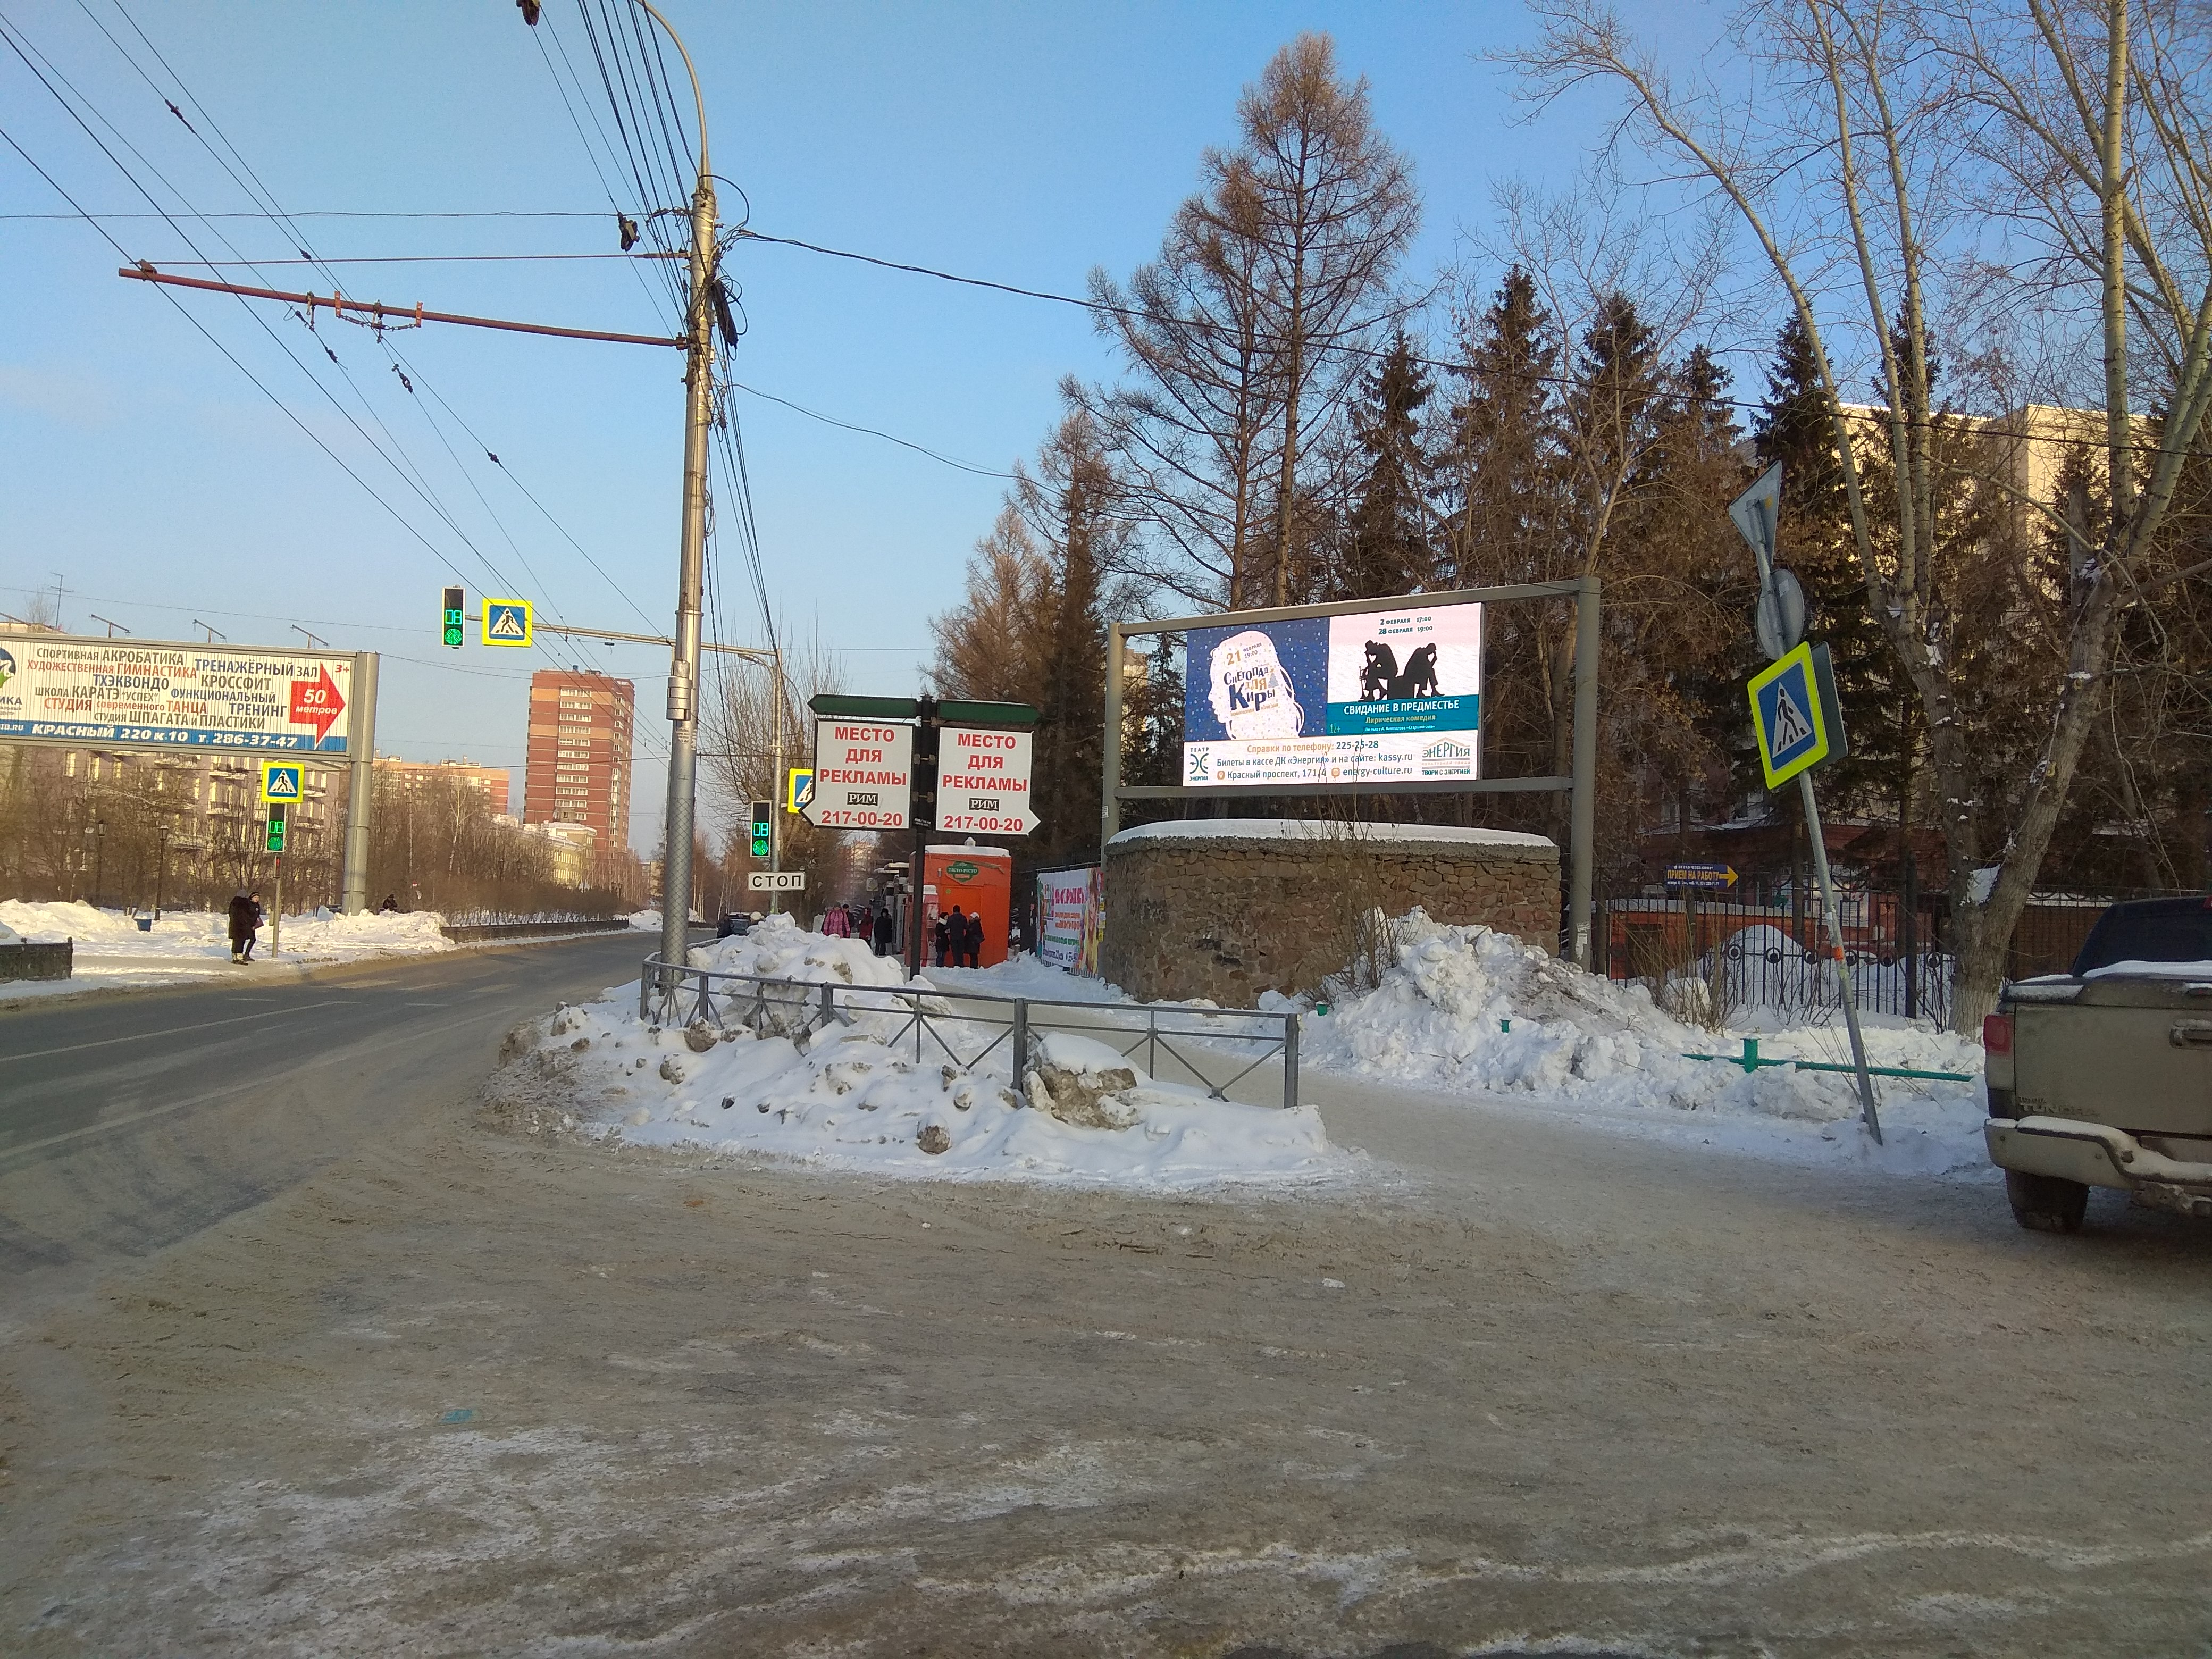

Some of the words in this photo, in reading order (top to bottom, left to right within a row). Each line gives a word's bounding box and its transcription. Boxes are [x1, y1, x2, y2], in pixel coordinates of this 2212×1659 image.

[37, 647, 99, 660] СПОРТИВНАЯ
[102, 649, 183, 665] АКРОБАТИКА
[1226, 650, 1241, 665] 21
[1243, 642, 1262, 652] ФЕВРАЛЯ
[1244, 650, 1258, 659] 19:00
[27, 659, 114, 674] ХУДОЖЕСТВЕННАЯ
[117, 663, 197, 678] ГИМНАСТИКА
[195, 658, 294, 676] ТРЕНАЖЁРНЫЙ
[297, 666, 317, 677] ЗАЛ
[93, 674, 169, 692] ТХЭКВОНДО
[201, 675, 272, 690] КРОССФИТ
[35, 686, 69, 697] ШКОЛА
[72, 685, 120, 700] КАРАТЭ
[171, 688, 276, 703] ФУНКЦИОНАЛЬНЫЙ
[304, 689, 326, 703] 50
[44, 698, 92, 713] СТУДИЯ
[97, 700, 164, 710] современного
[166, 700, 207, 715] ТАНЦА
[229, 702, 287, 717] ТРЕНИНГ
[296, 706, 338, 715] метров
[1344, 703, 1390, 715] СВИДАНИЕ
[1393, 703, 1399, 711] В
[1401, 700, 1460, 713] ПРЕДМЕСТЬЕ
[95, 713, 127, 723] СТУДИЯ
[129, 711, 188, 725] ШПАГАТА
[191, 717, 197, 726] и
[199, 715, 265, 729] ПЛАСТИКИ
[32, 723, 115, 738] КРАСНЫЙ
[120, 728, 152, 740] 220
[213, 733, 298, 748] 286-37-47
[834, 726, 895, 742] МЕСТО
[1330, 723, 1340, 733] 12+
[958, 733, 1017, 749] МЕСТО
[1247, 744, 1279, 754] Справки
[1293, 742, 1334, 753] телефону:
[1336, 740, 1379, 749] 225-25-28
[845, 748, 882, 764] ДЛЯ
[1422, 742, 1470, 758] ЭНЕРГИЯ
[967, 755, 1003, 770] ДЛЯ
[1217, 758, 1244, 767] Билеты
[1275, 757, 1285, 766] ДК
[1288, 756, 1329, 765] «Энергия»
[1378, 752, 1412, 764] kassy.ru
[819, 769, 907, 785] РЕКЛАМЫ
[1227, 770, 1260, 779] Красный
[1262, 770, 1300, 780] проспект,
[1343, 766, 1412, 778] energy-culture.ru
[942, 774, 1027, 792] РЕКЛАМЫ
[849, 794, 877, 803] РИМ
[970, 799, 998, 809] РИМ
[821, 810, 903, 826] 217-00-20
[943, 815, 1023, 832] 217-00-20
[752, 875, 801, 887] СТОП
[1667, 869, 1687, 879] ПРИЕМ
[1688, 870, 1696, 880] НА
[1697, 871, 1719, 881] РАБОТУ
